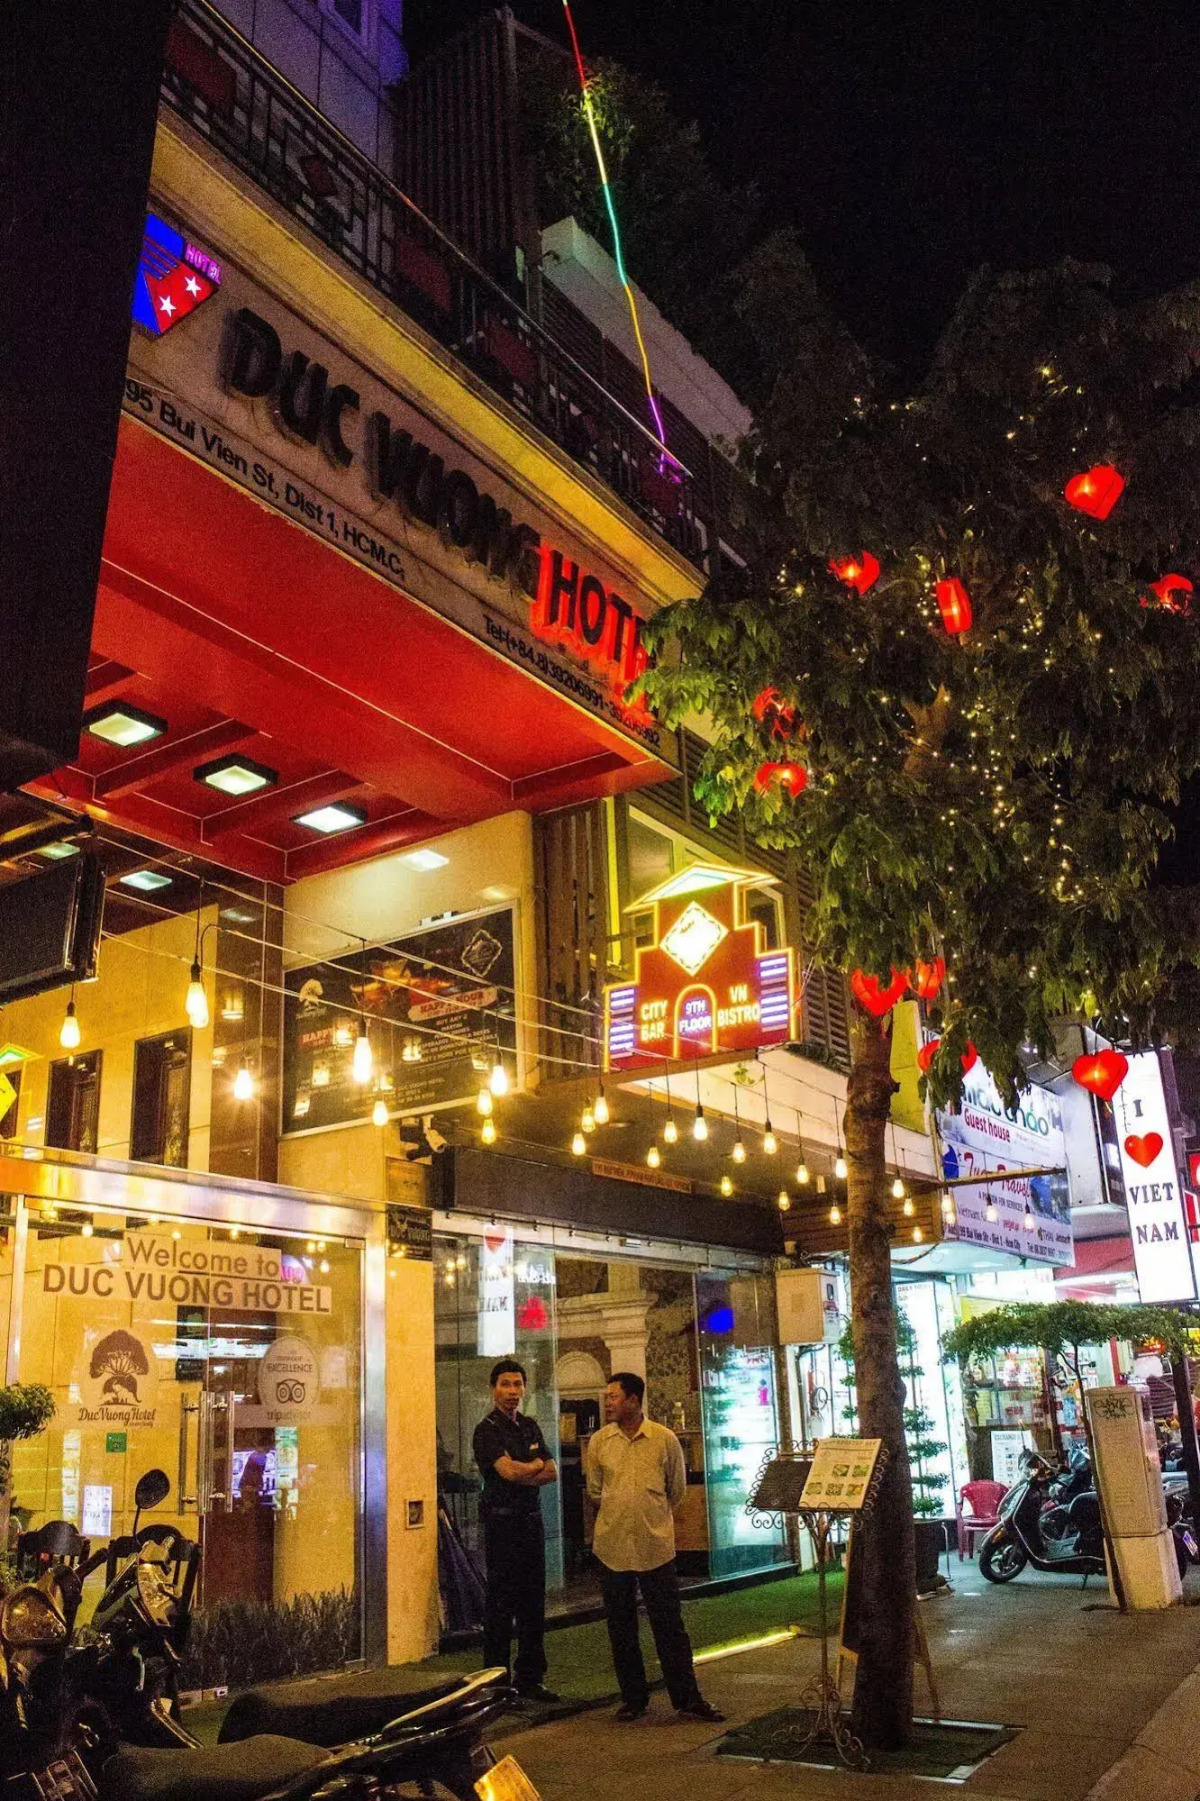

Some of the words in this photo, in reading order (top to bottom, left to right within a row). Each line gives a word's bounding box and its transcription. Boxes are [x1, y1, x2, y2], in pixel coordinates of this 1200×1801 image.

[159, 401, 196, 442] Bui
[202, 427, 248, 475] Vien
[252, 464, 280, 499] St,
[285, 483, 323, 523] Dist
[215, 307, 361, 469] DUC
[364, 411, 541, 600] VUONG
[729, 985, 747, 1003] VN
[641, 1001, 668, 1021] CITY
[685, 1000, 706, 1013] 9TH
[718, 1003, 760, 1027] BISTRO
[641, 1023, 665, 1041] BAR
[679, 1014, 712, 1033] FLOOR
[1132, 1099, 1145, 1118] I
[964, 1107, 988, 1134] Guest
[988, 1121, 1011, 1143] house
[1129, 1181, 1175, 1205] VIET
[1135, 1221, 1181, 1245] NAM
[127, 1236, 248, 1276] Welcome
[257, 1254, 279, 1278] to
[43, 1264, 114, 1297] DUC
[125, 1271, 233, 1306] VUONG
[242, 1281, 330, 1313] HOTEL
[267, 1363, 314, 1373] EXCELLENCE
[78, 1407, 99, 1421] Duc
[99, 1407, 131, 1426] Vuong
[131, 1407, 156, 1421] Hotel
